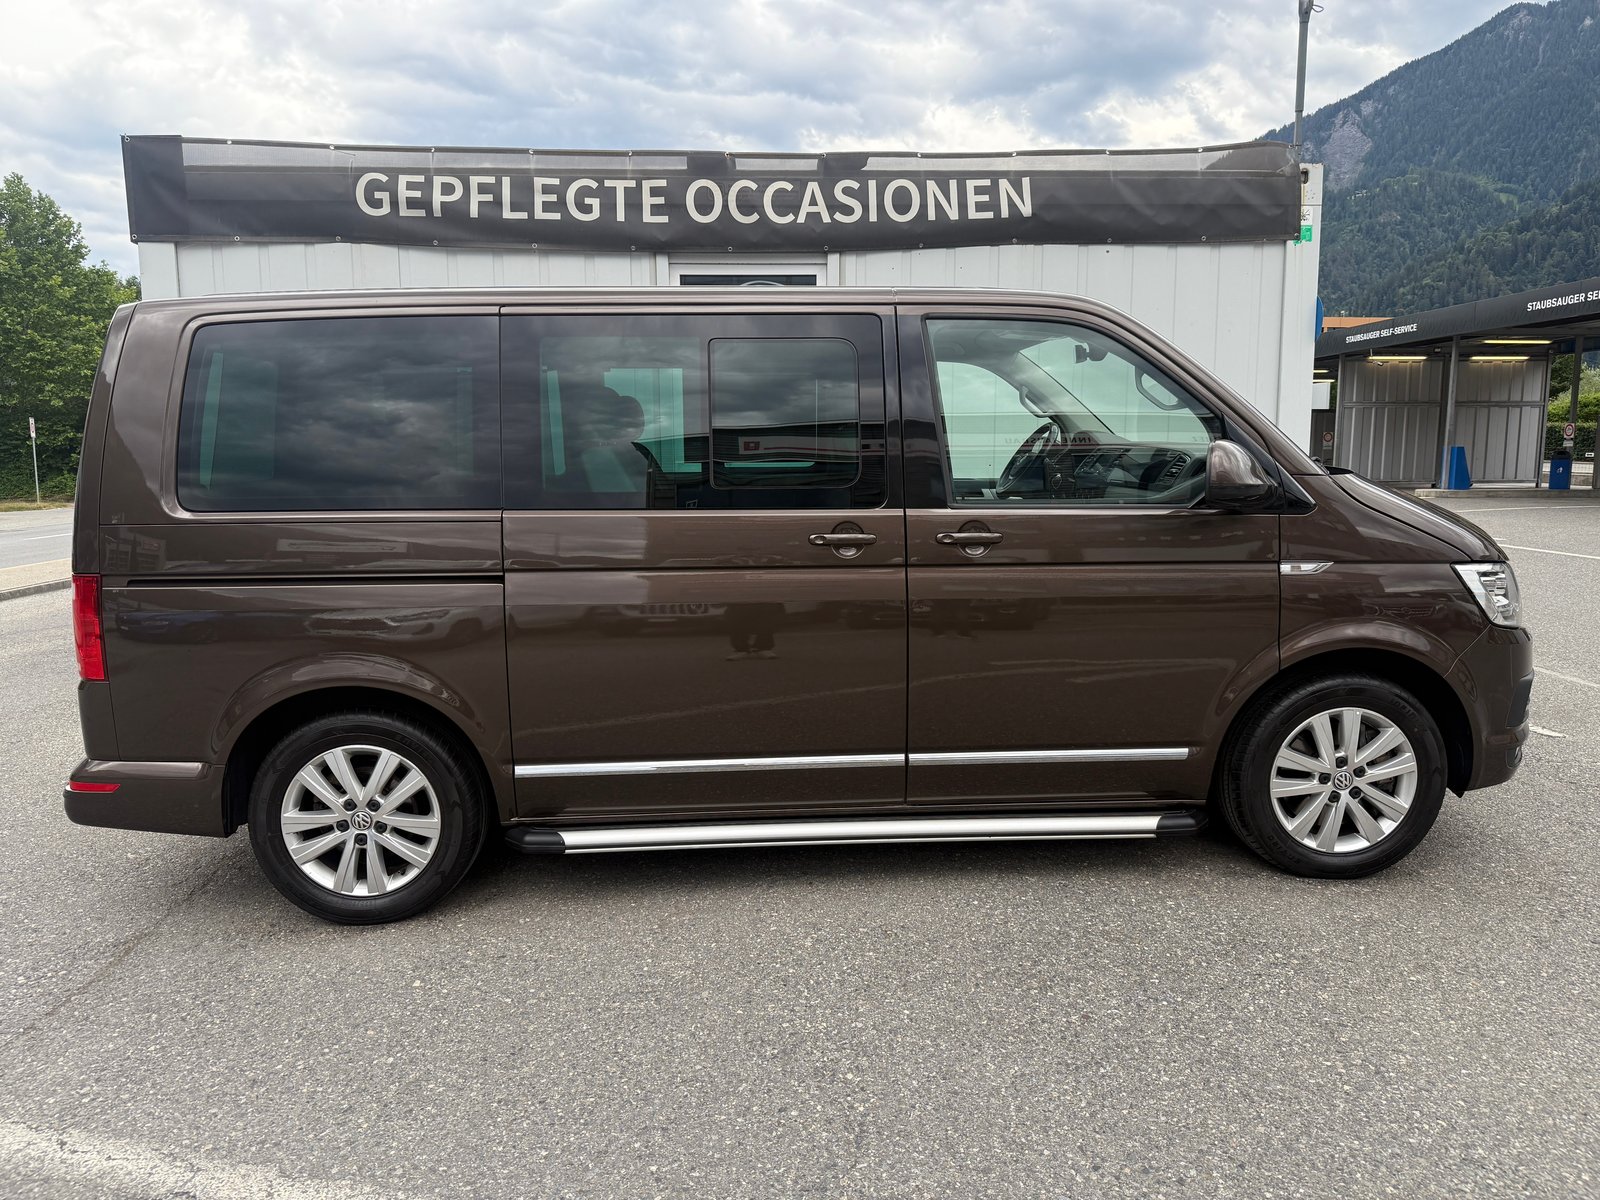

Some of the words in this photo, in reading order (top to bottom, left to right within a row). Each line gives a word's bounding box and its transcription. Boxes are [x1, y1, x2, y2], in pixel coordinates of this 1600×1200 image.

[356, 172, 669, 223] GEPFLEGTE
[685, 177, 1033, 224] OCCASIONEN
[1527, 293, 1585, 311] STAUBSAUGER
[1345, 330, 1380, 344] STAUBSAUGER
[1380, 323, 1418, 337] SELF-SERVICE
